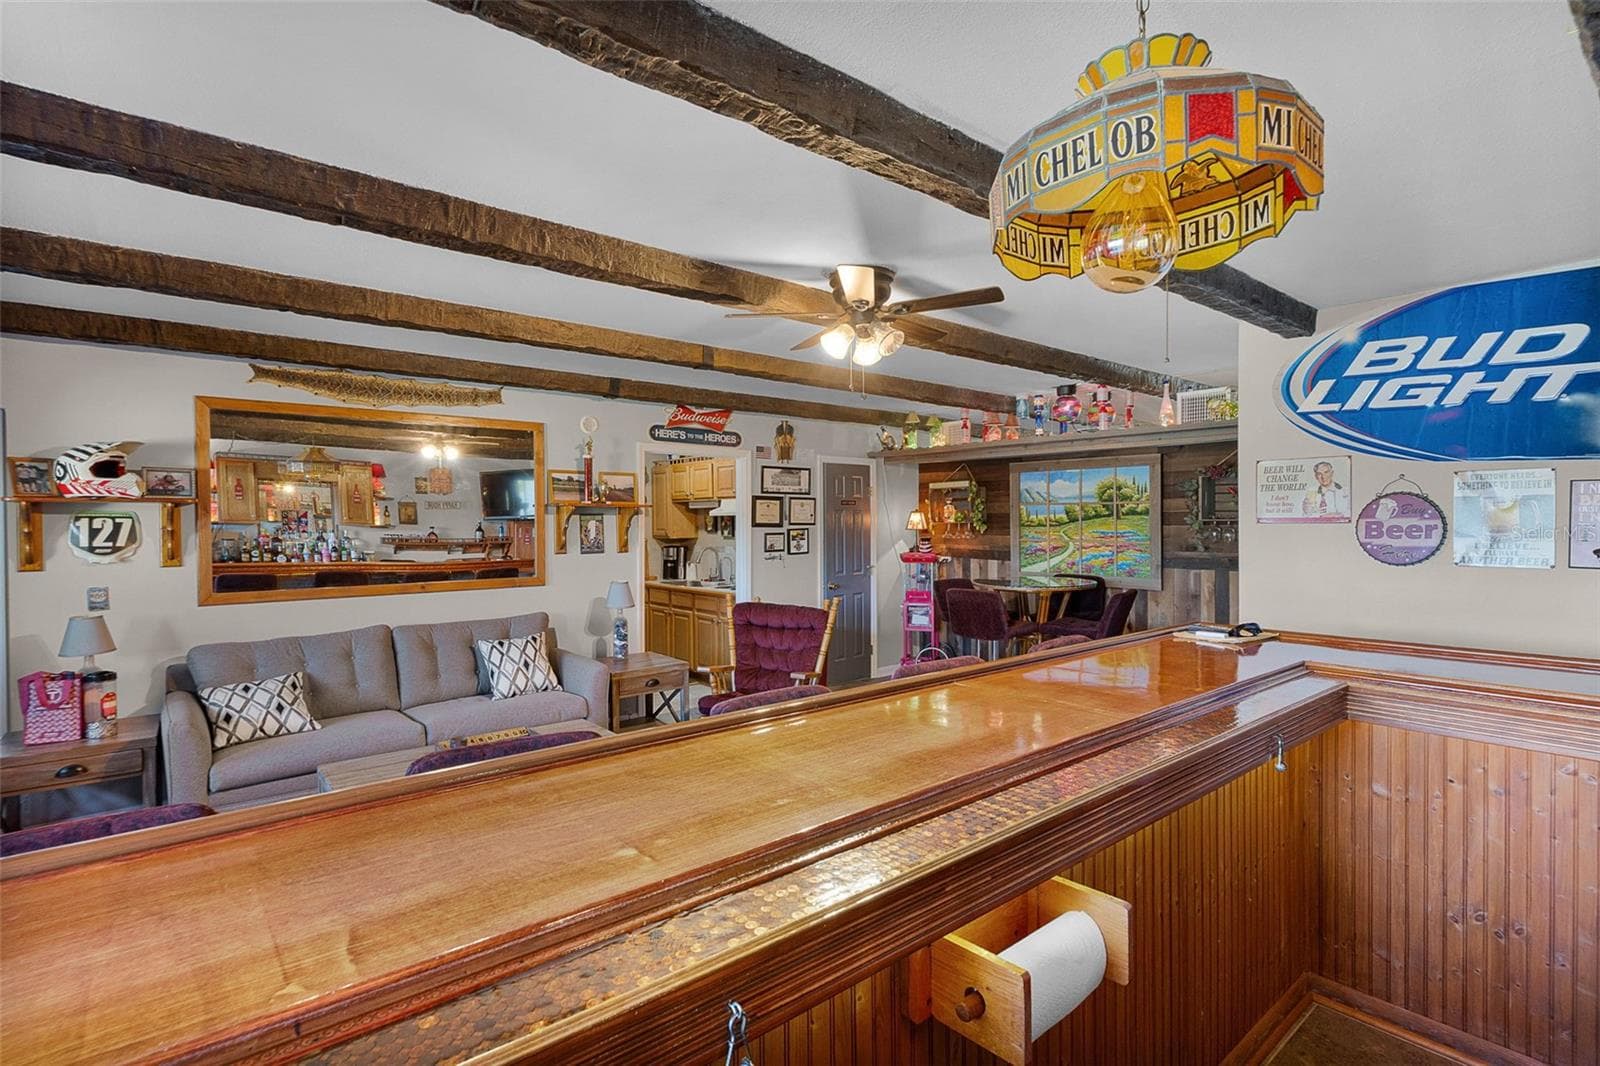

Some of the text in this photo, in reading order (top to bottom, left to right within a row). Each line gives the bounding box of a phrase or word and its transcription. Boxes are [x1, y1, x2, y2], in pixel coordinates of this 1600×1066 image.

[1342, 322, 1591, 378] BUD
[1296, 360, 1600, 413] LIGHT
[655, 428, 687, 440] HERE'S
[704, 432, 737, 444] HEROES
[1264, 465, 1305, 474] BEER WILL
[1266, 474, 1299, 483] CHANGE
[1260, 484, 1276, 493] THE
[75, 517, 133, 547] 127
[1364, 520, 1439, 540] Beer
[1458, 555, 1550, 566] ANOTHER BEER
